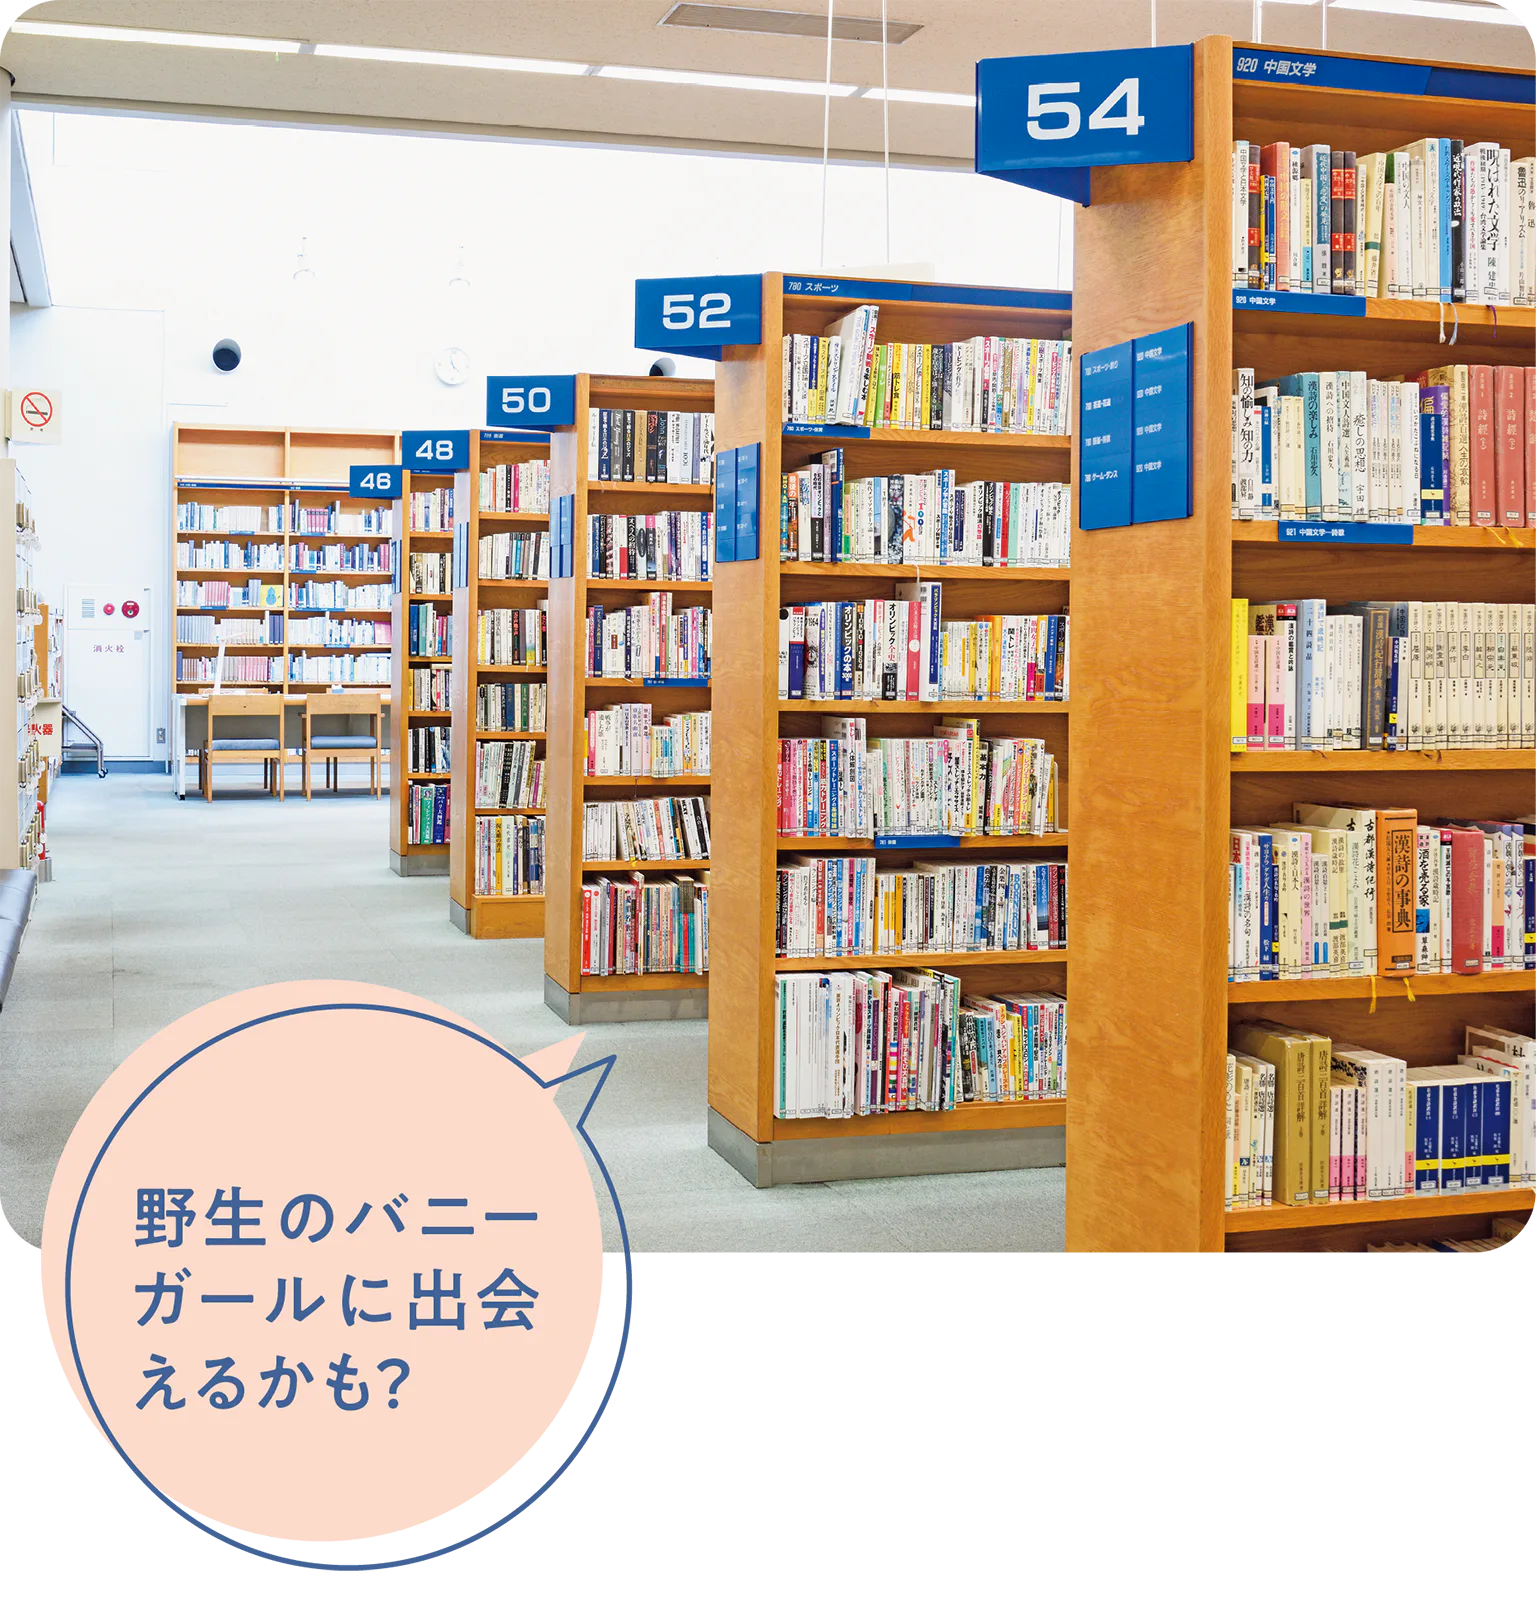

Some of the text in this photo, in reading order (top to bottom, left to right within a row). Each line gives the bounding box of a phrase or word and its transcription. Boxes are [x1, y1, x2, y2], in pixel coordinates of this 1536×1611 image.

[1236, 57, 1316, 77] 920 中国文学
[1027, 77, 1145, 140] 54
[1517, 166, 1527, 239] 魯迅のリアリズム
[662, 292, 731, 330] 52
[788, 282, 839, 294] 780 スポーツ
[1250, 296, 1276, 305] 中国文学
[501, 387, 551, 413] 50
[1307, 381, 1318, 439] 漢詩の楽しみ
[1325, 381, 1334, 432] 漢詩への招待
[1341, 380, 1350, 438] 中国文人詩選
[416, 440, 453, 460] 48
[1352, 412, 1366, 473] 癒しの思想
[360, 472, 391, 490] 46
[93, 644, 125, 653] 消火栓
[1364, 818, 1376, 902] 古都漢詩紀行
[1393, 834, 1412, 929] 漢詩の事典
[1418, 848, 1430, 907] 酒を売る家
[1011, 873, 1021, 938] BORN RUN
